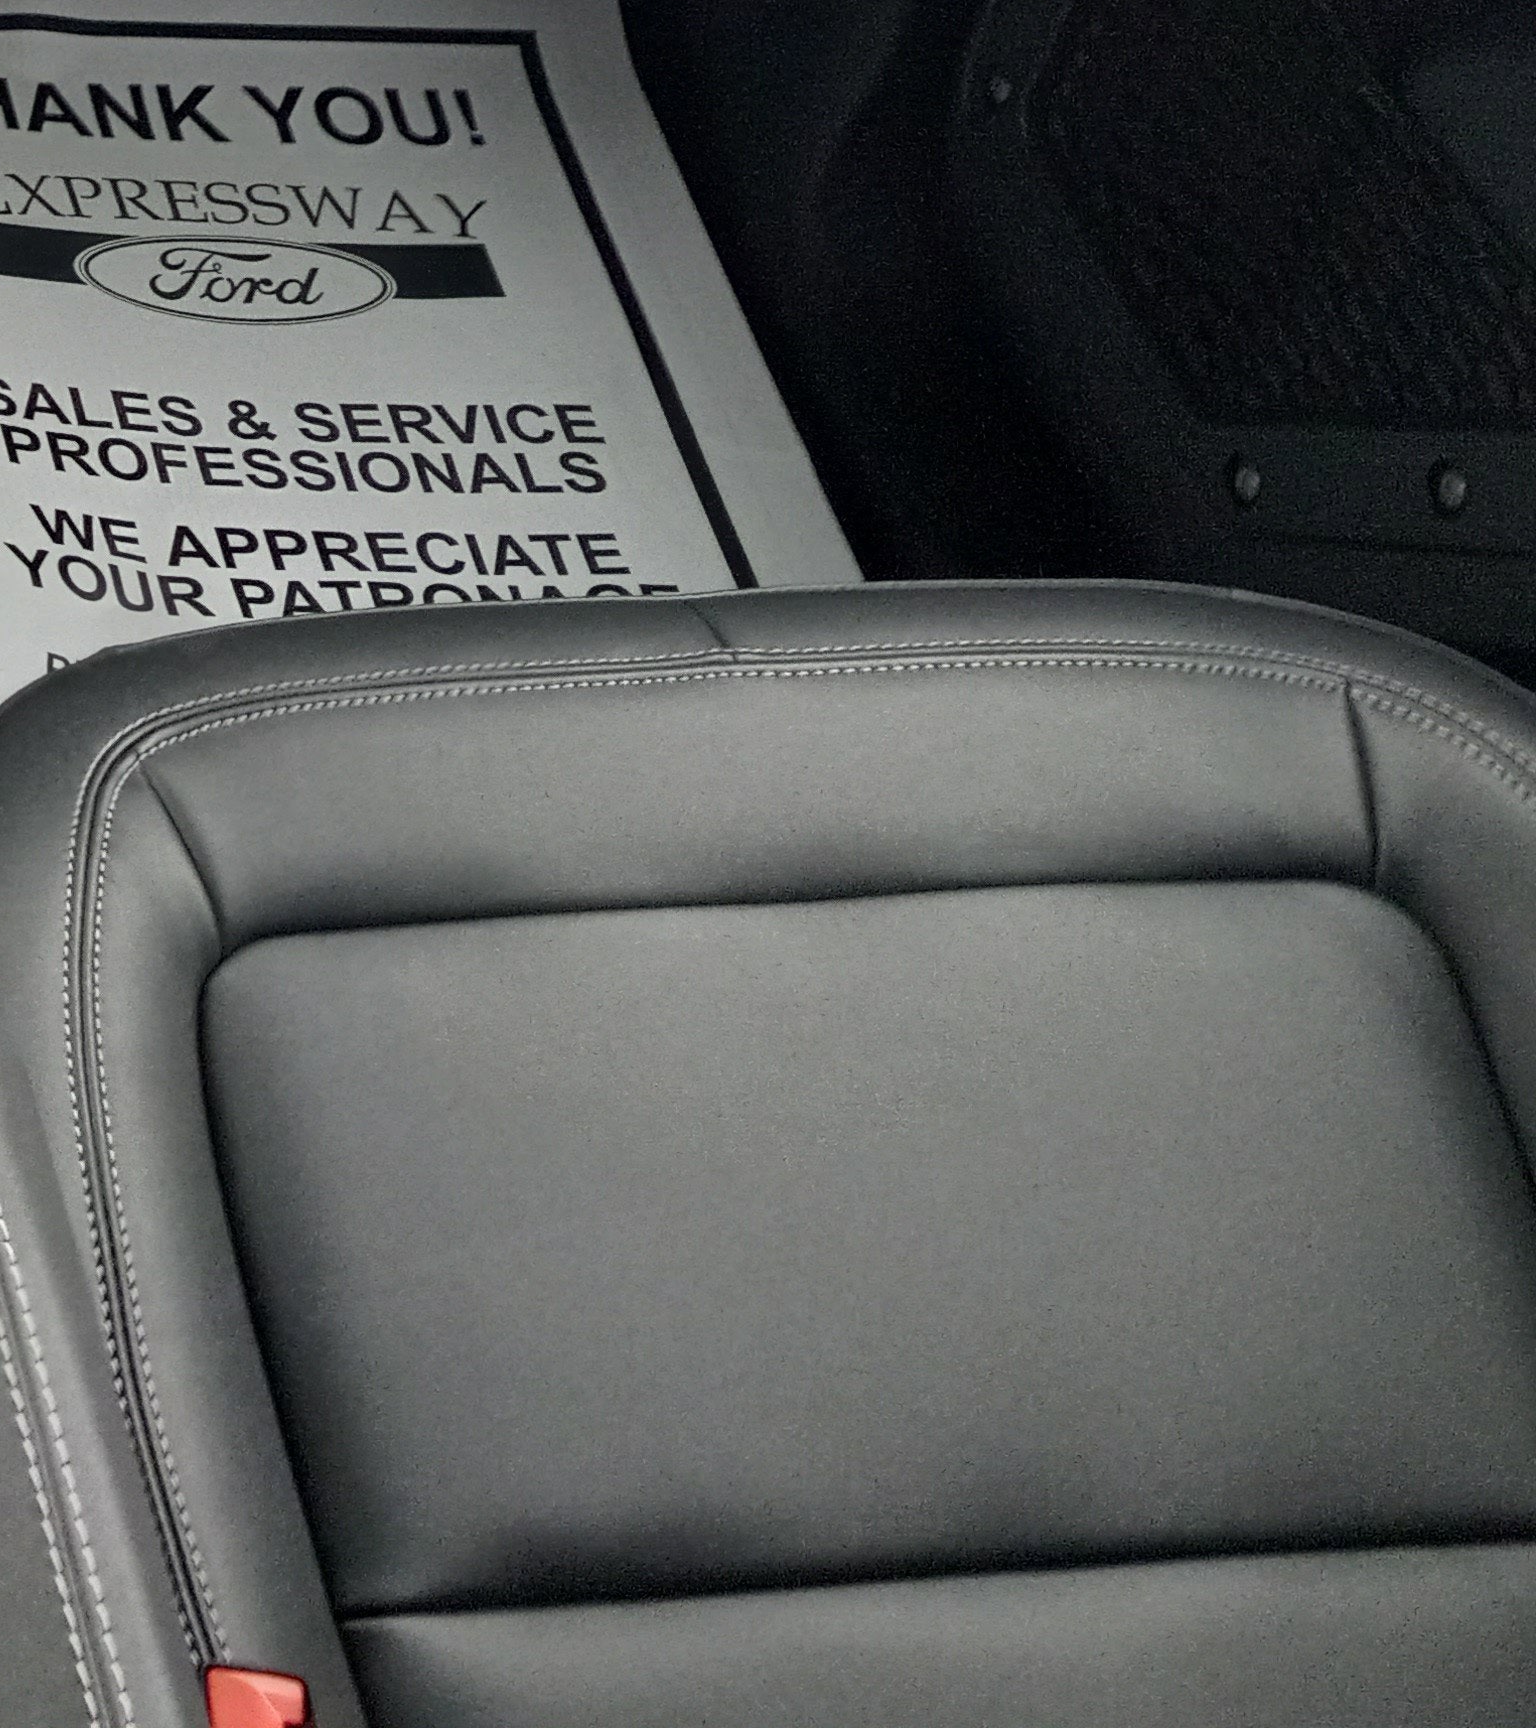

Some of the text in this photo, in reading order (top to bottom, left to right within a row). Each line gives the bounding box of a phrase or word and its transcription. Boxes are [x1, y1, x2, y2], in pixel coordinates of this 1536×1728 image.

[240, 85, 487, 149] YOU!
[148, 246, 325, 306] Ford
[227, 399, 277, 441] &
[294, 402, 607, 445] SERVICE
[29, 503, 632, 577] WE APPRECIATE
[4, 541, 216, 618] YOUR
